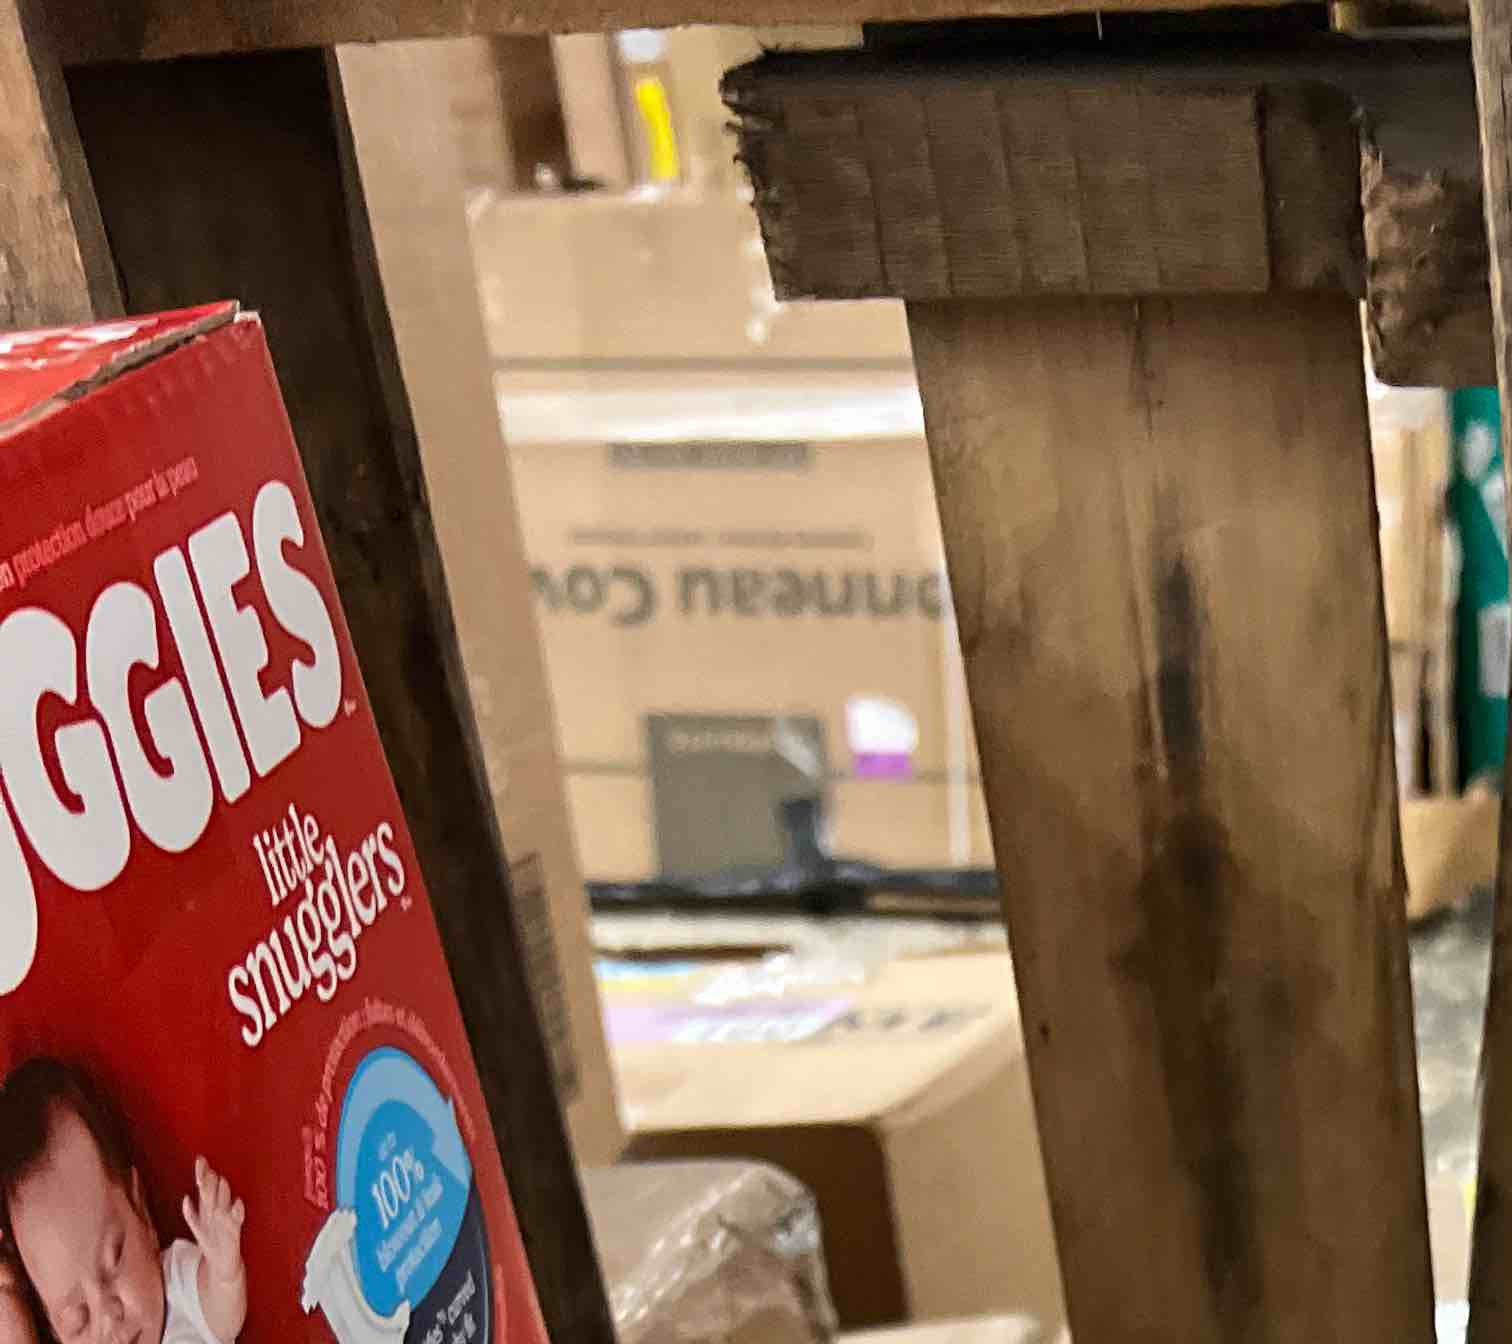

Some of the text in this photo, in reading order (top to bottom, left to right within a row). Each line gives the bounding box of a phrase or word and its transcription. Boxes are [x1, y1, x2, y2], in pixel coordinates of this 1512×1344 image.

[524, 559, 947, 628] onneau Cov
[0, 480, 343, 996] GGIES
[253, 802, 325, 906] little
[228, 821, 406, 1048] snugglers
[371, 1149, 424, 1229] 100%
